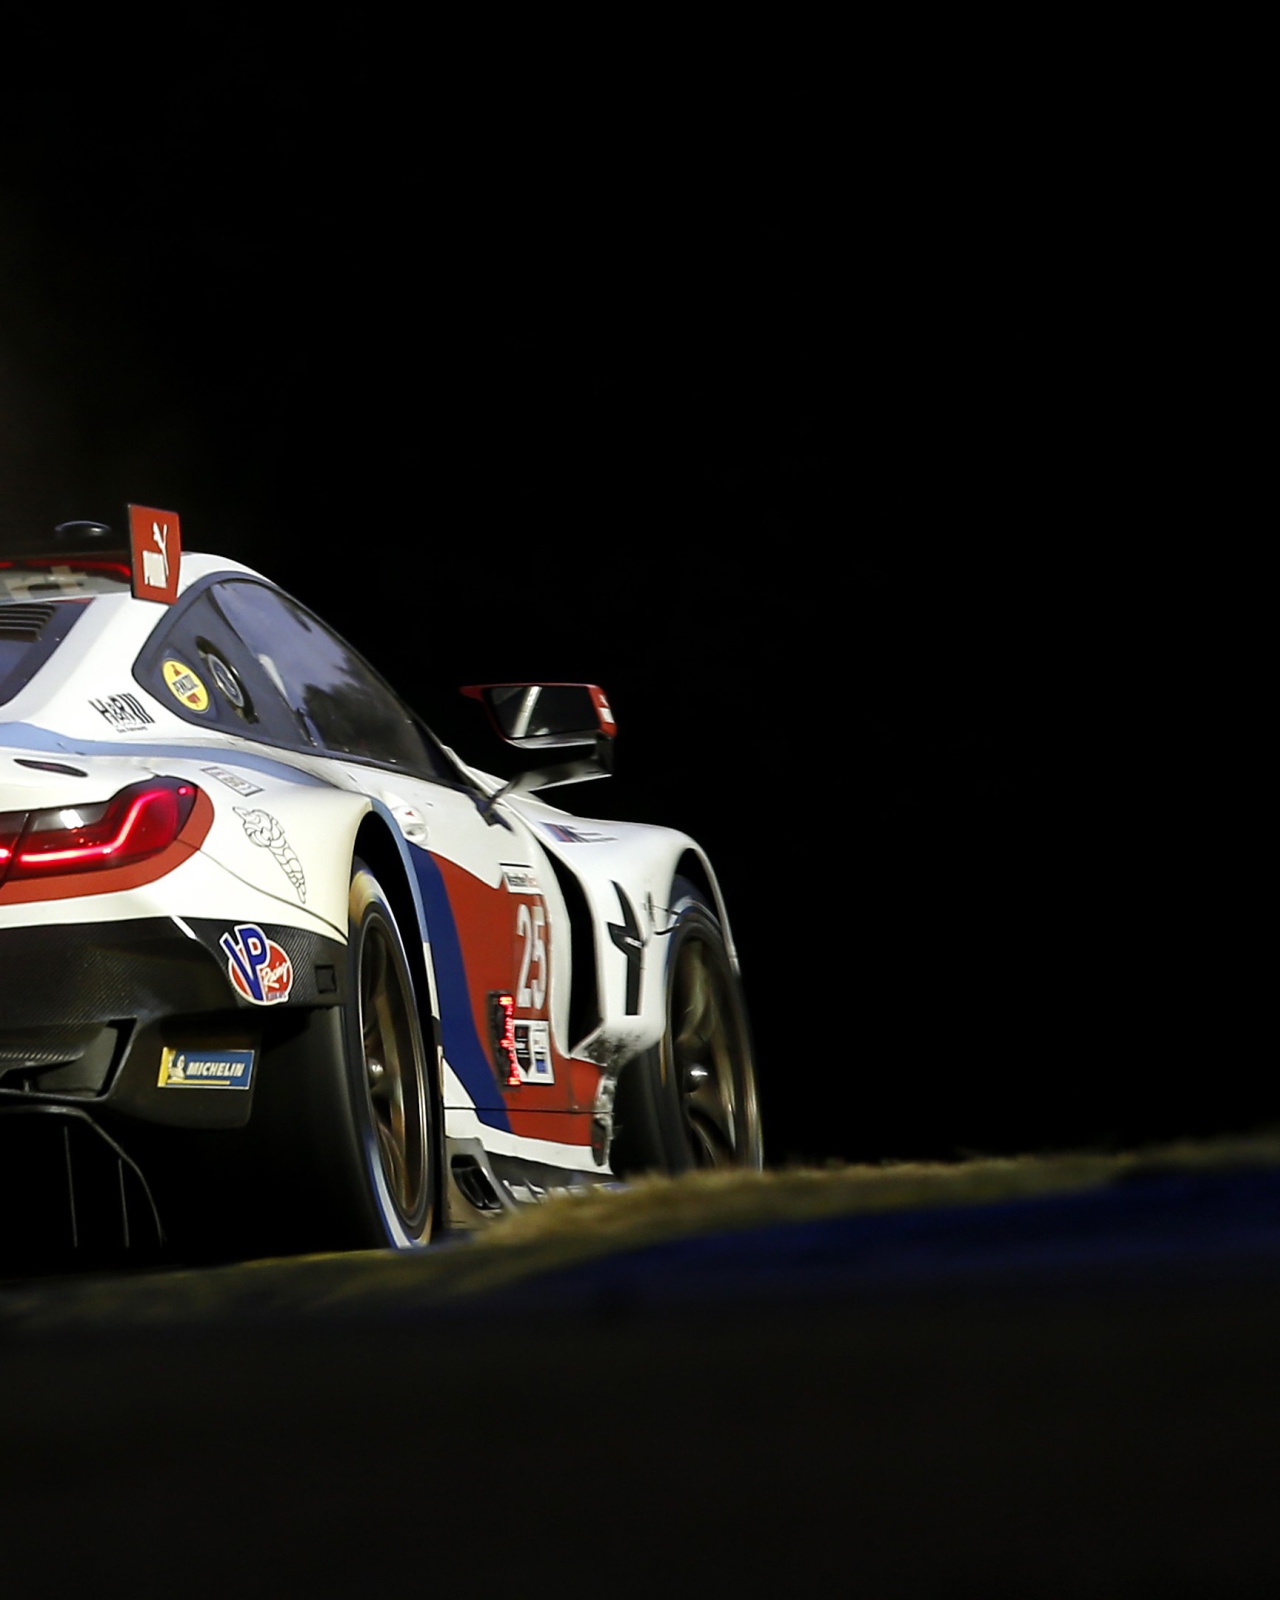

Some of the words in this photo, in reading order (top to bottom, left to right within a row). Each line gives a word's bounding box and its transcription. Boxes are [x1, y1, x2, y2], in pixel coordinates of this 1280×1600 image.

[222, 926, 269, 1002] VP
[517, 903, 547, 1010] 25
[186, 1062, 246, 1077] MICHELIN
